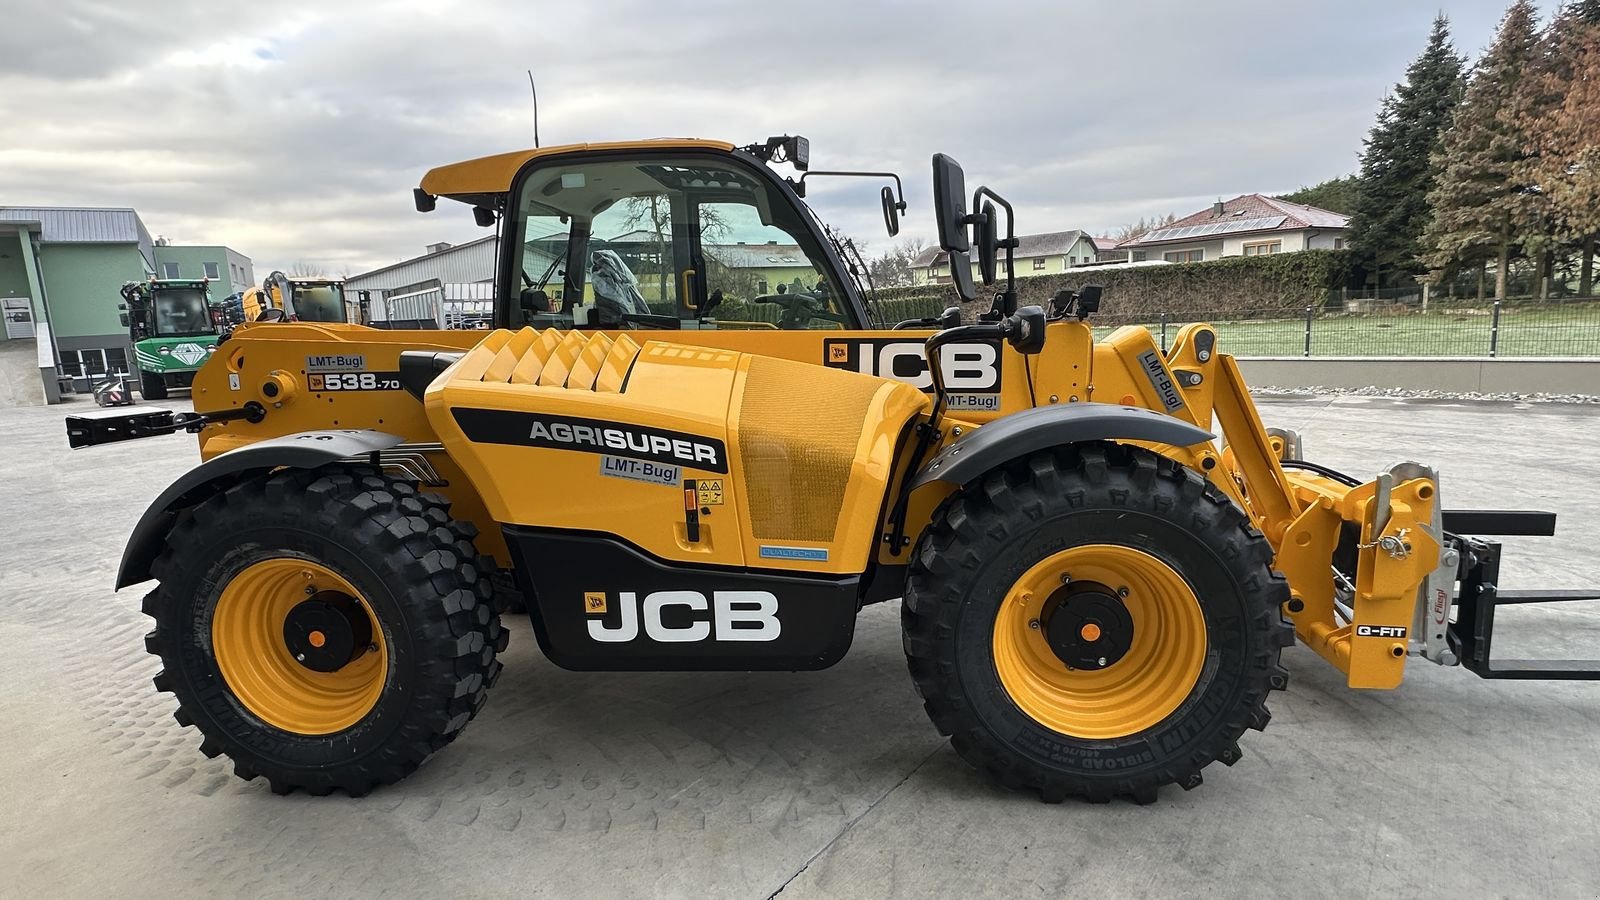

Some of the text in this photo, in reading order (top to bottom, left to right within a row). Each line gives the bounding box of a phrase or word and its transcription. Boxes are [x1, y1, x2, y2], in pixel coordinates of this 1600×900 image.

[309, 356, 363, 368] LMT-Bugl
[1144, 352, 1183, 409] LMT-Bugl
[946, 396, 997, 408] MT-Bugl
[529, 421, 718, 465] AGRISUPER
[605, 457, 678, 482] LMT-Bugl
[587, 591, 781, 643] JCB
[1358, 626, 1406, 638] Q-FIT
